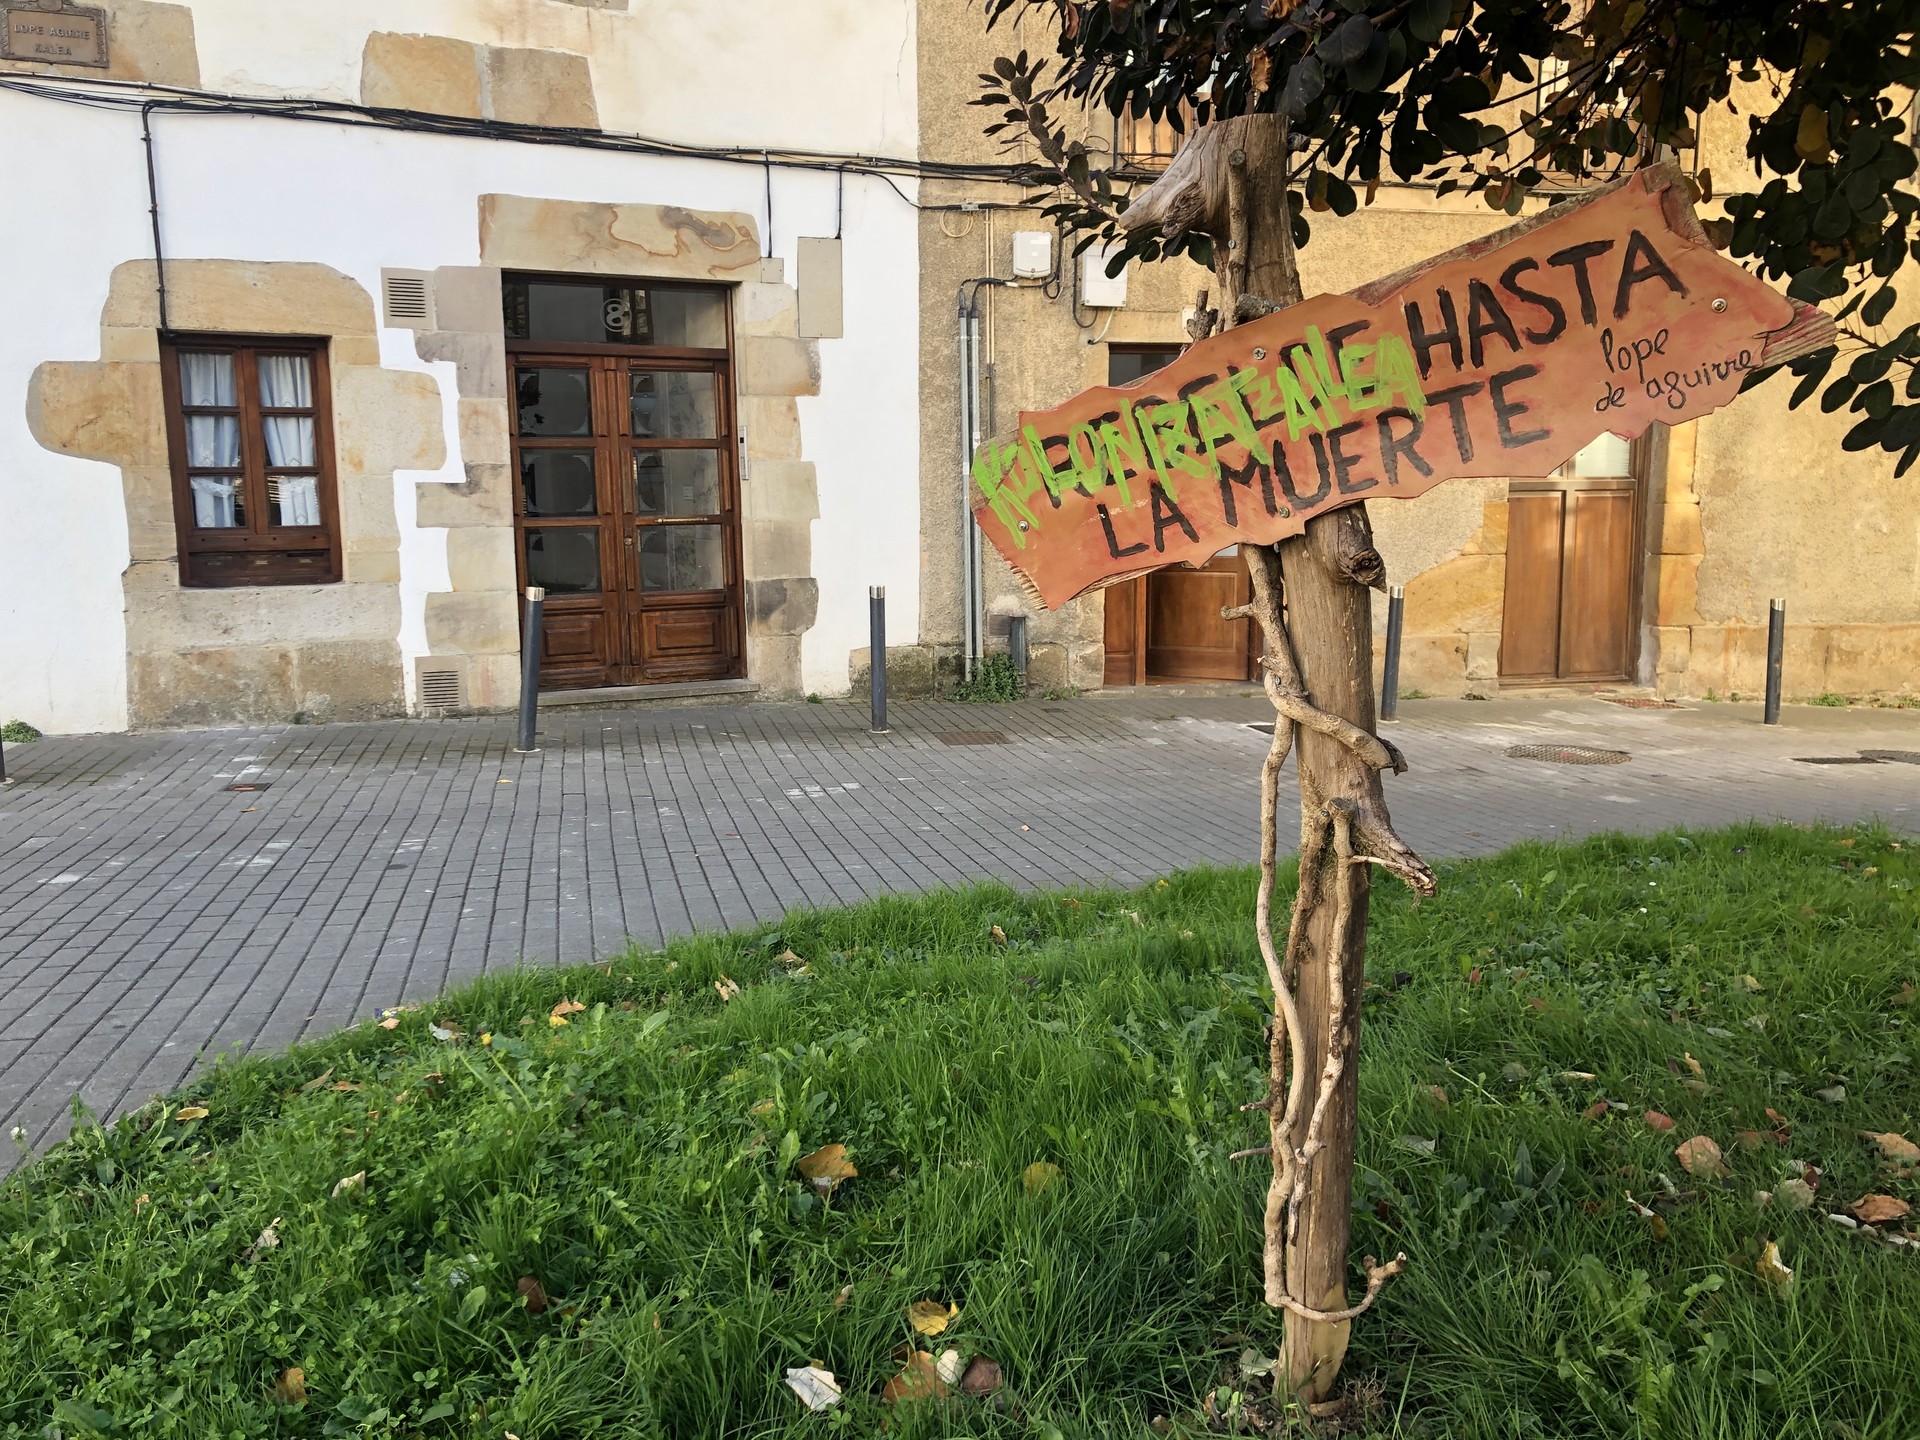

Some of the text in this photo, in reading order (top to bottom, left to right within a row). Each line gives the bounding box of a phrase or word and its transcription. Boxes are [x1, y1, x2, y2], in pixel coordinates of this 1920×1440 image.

[14, 24, 90, 40] LOPE AGIRRE
[35, 43, 72, 55] KALEA
[604, 302, 628, 328] 8
[1404, 229, 1688, 380] HASTA
[1595, 349, 1754, 412] de aguirre
[1097, 364, 1551, 559] LA MUERTE
